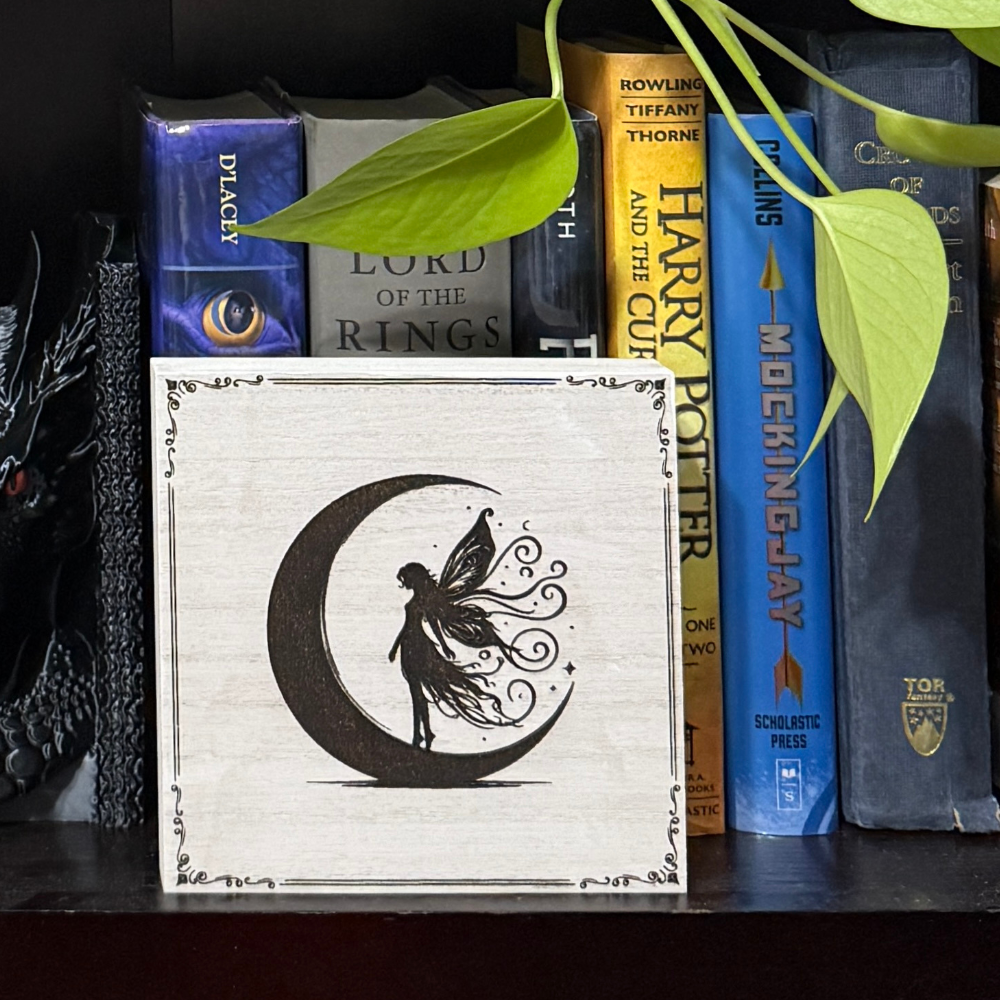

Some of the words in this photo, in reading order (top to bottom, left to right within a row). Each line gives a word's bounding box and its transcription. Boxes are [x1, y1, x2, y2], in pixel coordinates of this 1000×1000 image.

[620, 78, 702, 92] ROWLING
[626, 103, 699, 117] TIFFANY
[626, 129, 700, 142] THORNE
[890, 176, 924, 195] OF
[219, 153, 239, 245] D'LACEY
[630, 189, 648, 237] AND
[350, 246, 486, 276] LORD
[631, 241, 650, 283] THE
[657, 181, 706, 359] HARRY
[377, 289, 410, 308] OF
[416, 287, 467, 306] THE
[335, 315, 500, 353] RINGS
[759, 324, 804, 630] MOCKINGJAY
[686, 616, 716, 632] ONE
[903, 677, 945, 693] TOR
[755, 714, 821, 730] SCHOLASTIC
[771, 733, 807, 749] PRESS
